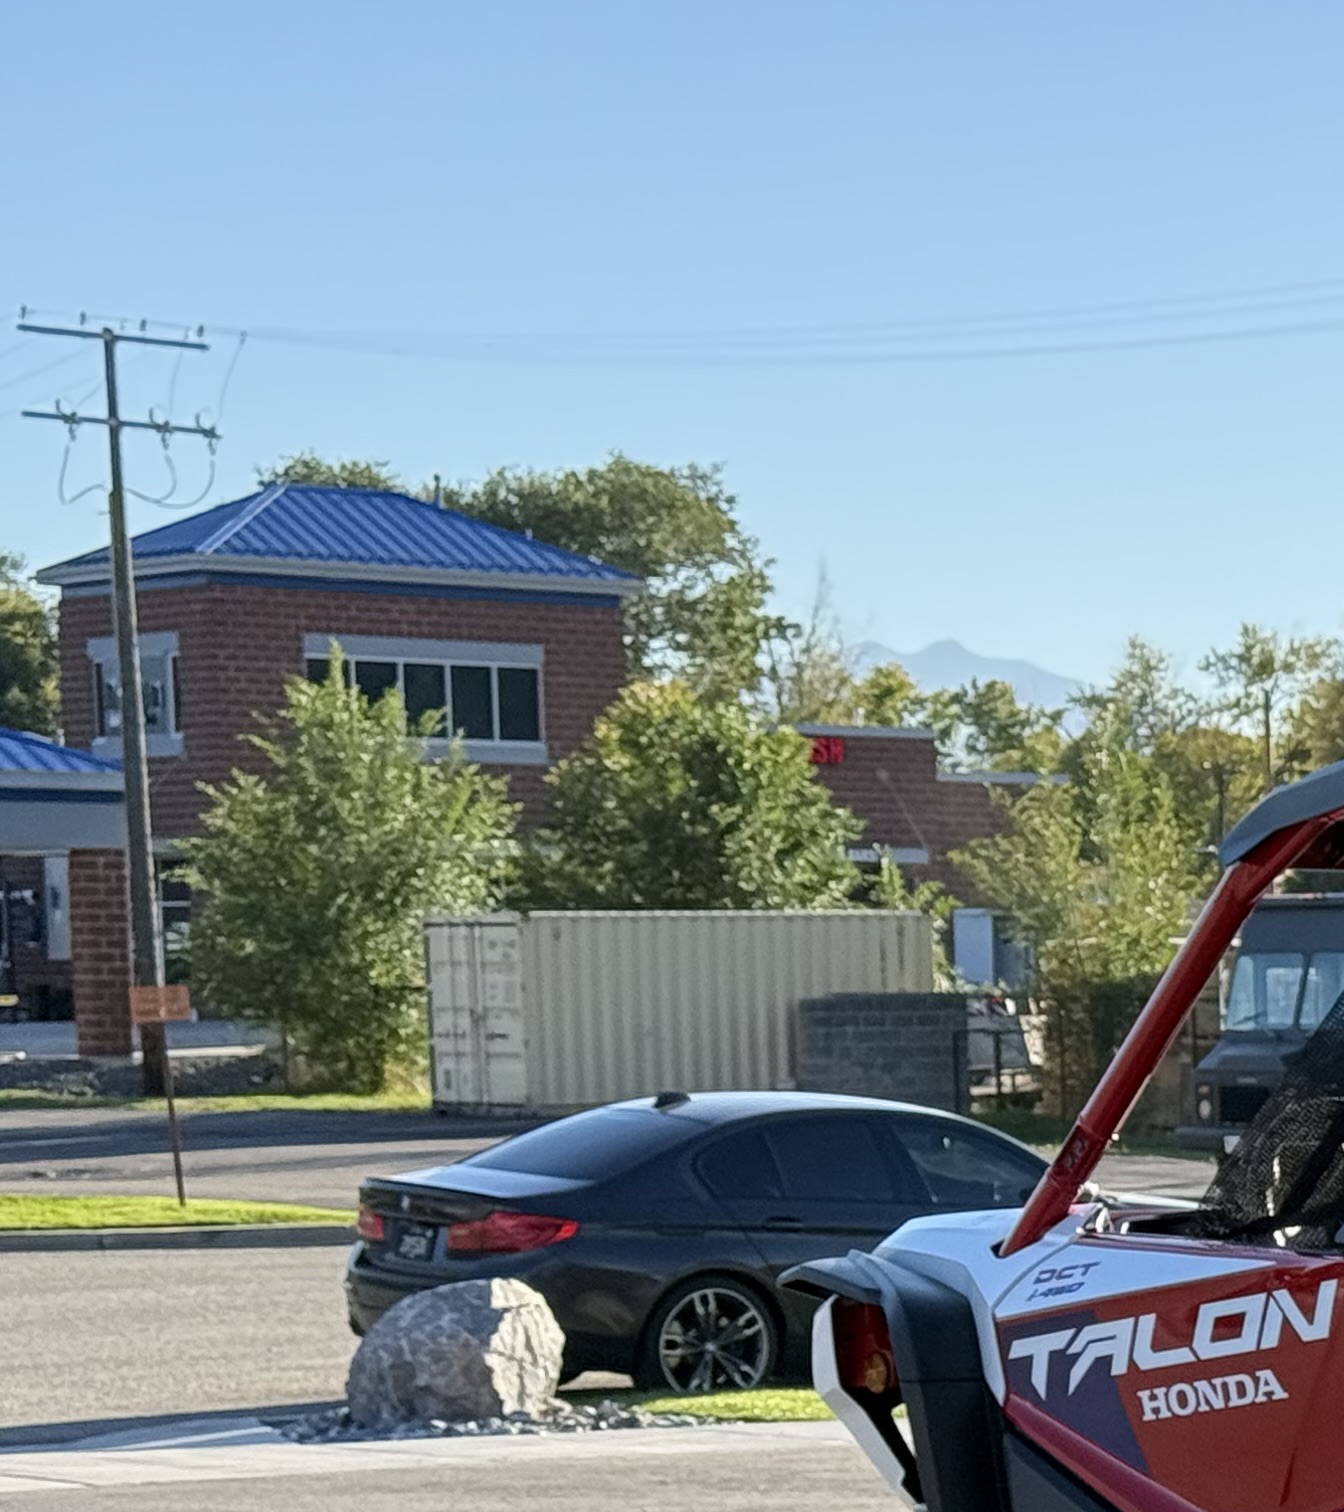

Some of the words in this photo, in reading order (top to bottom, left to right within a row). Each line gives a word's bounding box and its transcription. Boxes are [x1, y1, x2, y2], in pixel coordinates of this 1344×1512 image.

[1033, 1261, 1102, 1285] DCT
[1007, 1278, 1338, 1400] TALON
[1136, 1369, 1289, 1421] HONDA
